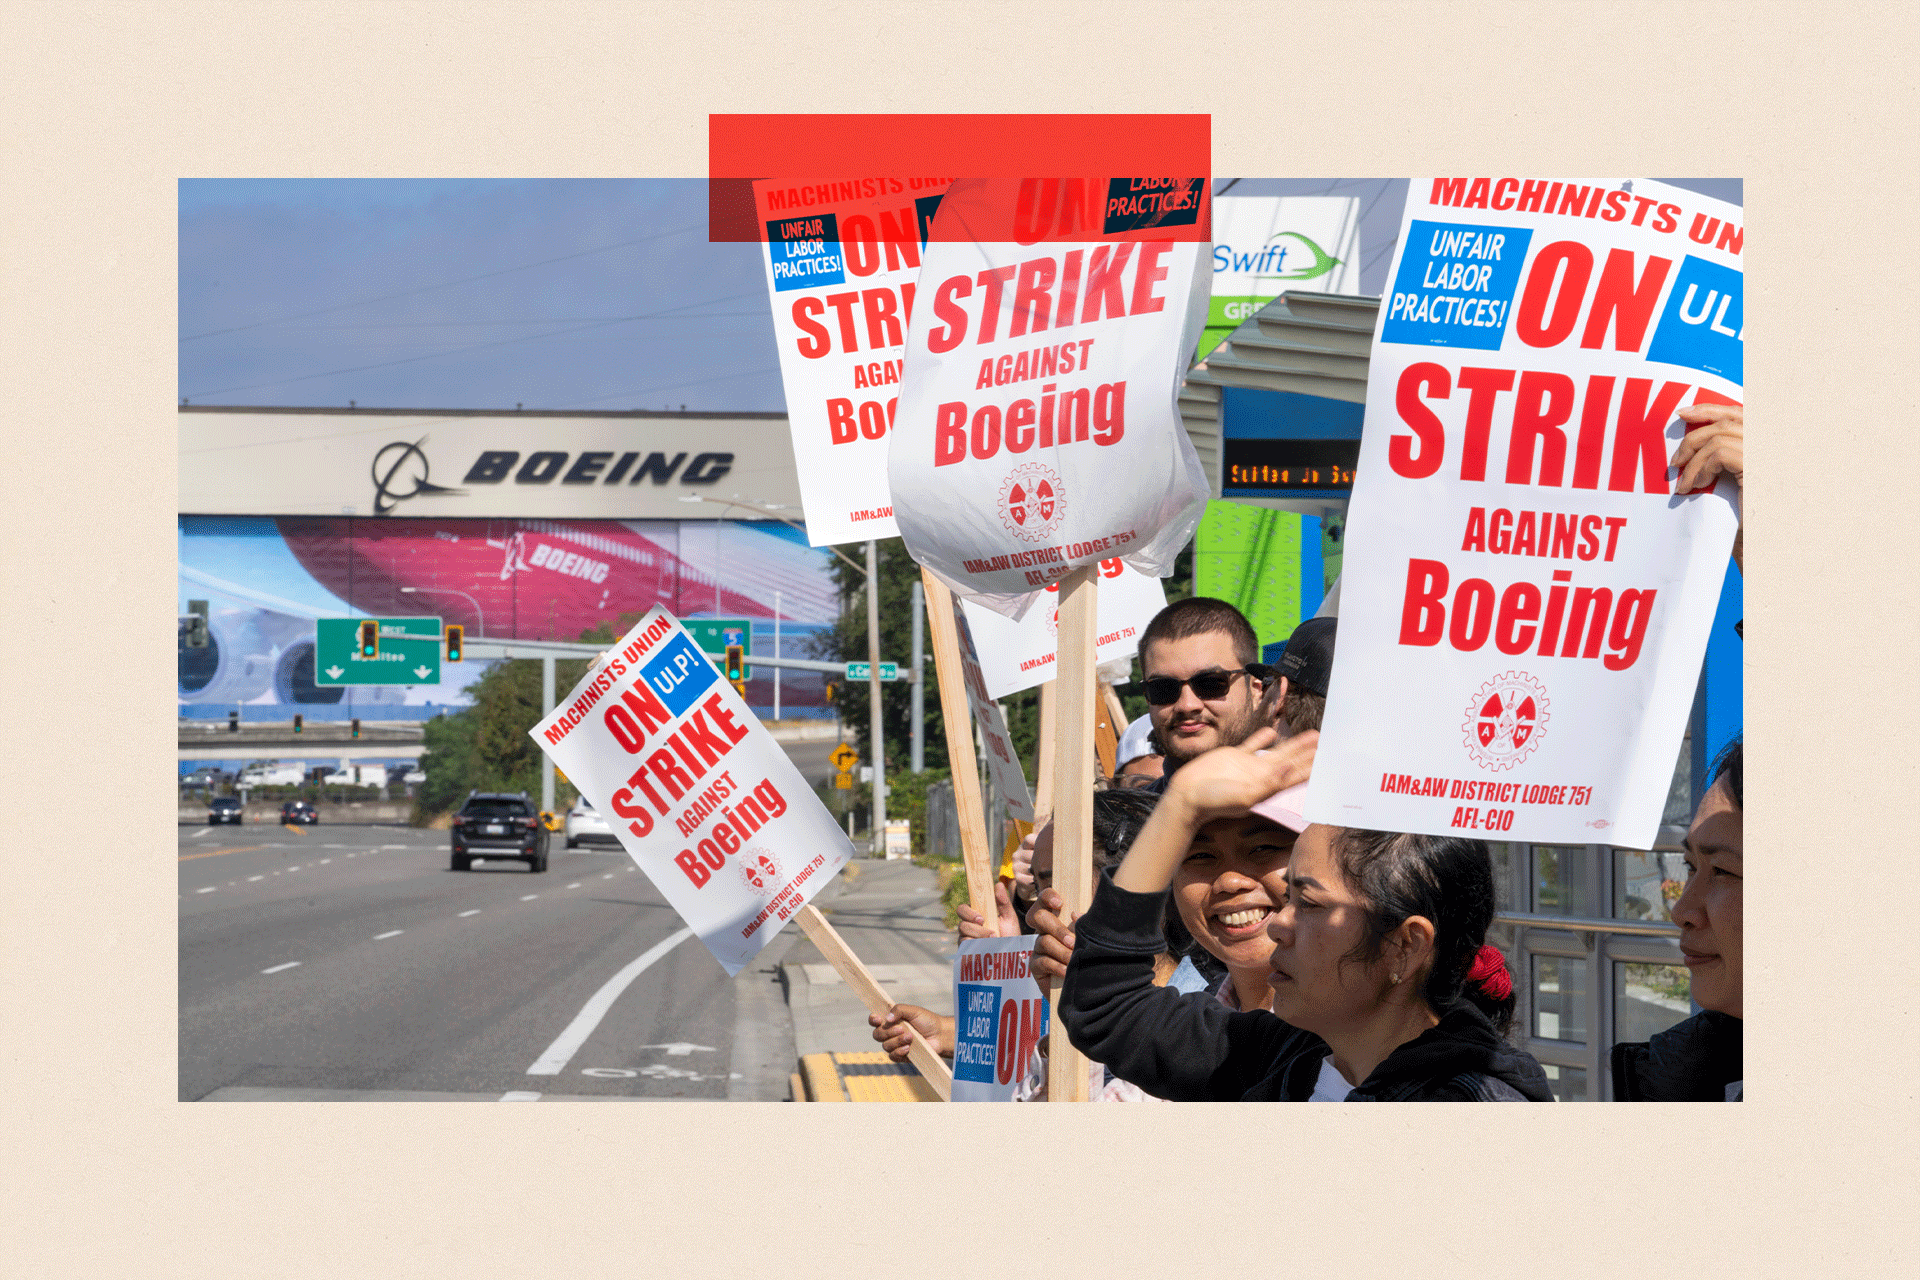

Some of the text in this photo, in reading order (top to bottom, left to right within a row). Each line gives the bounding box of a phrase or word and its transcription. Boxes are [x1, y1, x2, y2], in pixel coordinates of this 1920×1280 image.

[766, 178, 903, 212] MACHINISTS
[1106, 190, 1199, 218] PRACTICES!
[1429, 178, 1682, 234] MACHINISTS
[780, 218, 825, 239] UNFAIR
[841, 207, 921, 278] ON
[1429, 229, 1506, 261] UNFAIR
[785, 238, 825, 258] LABOR
[1213, 244, 1287, 273] Swift
[773, 255, 842, 280] PRACTICES!
[1422, 261, 1492, 292] LABOR
[927, 237, 1175, 354] STRIKE
[1389, 292, 1508, 328] PRACTICES!
[1516, 240, 1673, 353] ON
[976, 338, 1095, 390] AGAINST
[934, 381, 1127, 468] Boeing
[461, 450, 735, 486] BOEING
[850, 506, 893, 522] IAM&AW
[963, 529, 1137, 574] IAM&AW DISTRICT LODGE 751
[1460, 506, 1627, 562] AGAINST
[529, 543, 610, 584] BOEING
[1398, 558, 1658, 671] Boeing
[1096, 626, 1136, 647] LODGE 751
[543, 614, 672, 746] MACHINISTS UNION
[653, 647, 699, 694] ULP!
[1020, 653, 1055, 671] IAM&AW
[604, 677, 672, 755] ON
[611, 691, 750, 838] STRIKE
[675, 770, 738, 838] AGAINST
[1380, 773, 1593, 805] IAM&AW DISTRICT LODGE 751
[673, 777, 788, 890] Boeing
[1450, 806, 1515, 832] AFL-CIO
[740, 910, 770, 939] IAM&AW
[765, 883, 796, 914] DISTRICT
[792, 864, 816, 888] LODGE
[811, 854, 826, 870] 751
[777, 892, 805, 922] AFL-CIO
[967, 990, 994, 1013] UNFAIR
[966, 1016, 991, 1039] LABOR
[997, 998, 1043, 1086] ON
[956, 1041, 996, 1066] PRACTICES!
